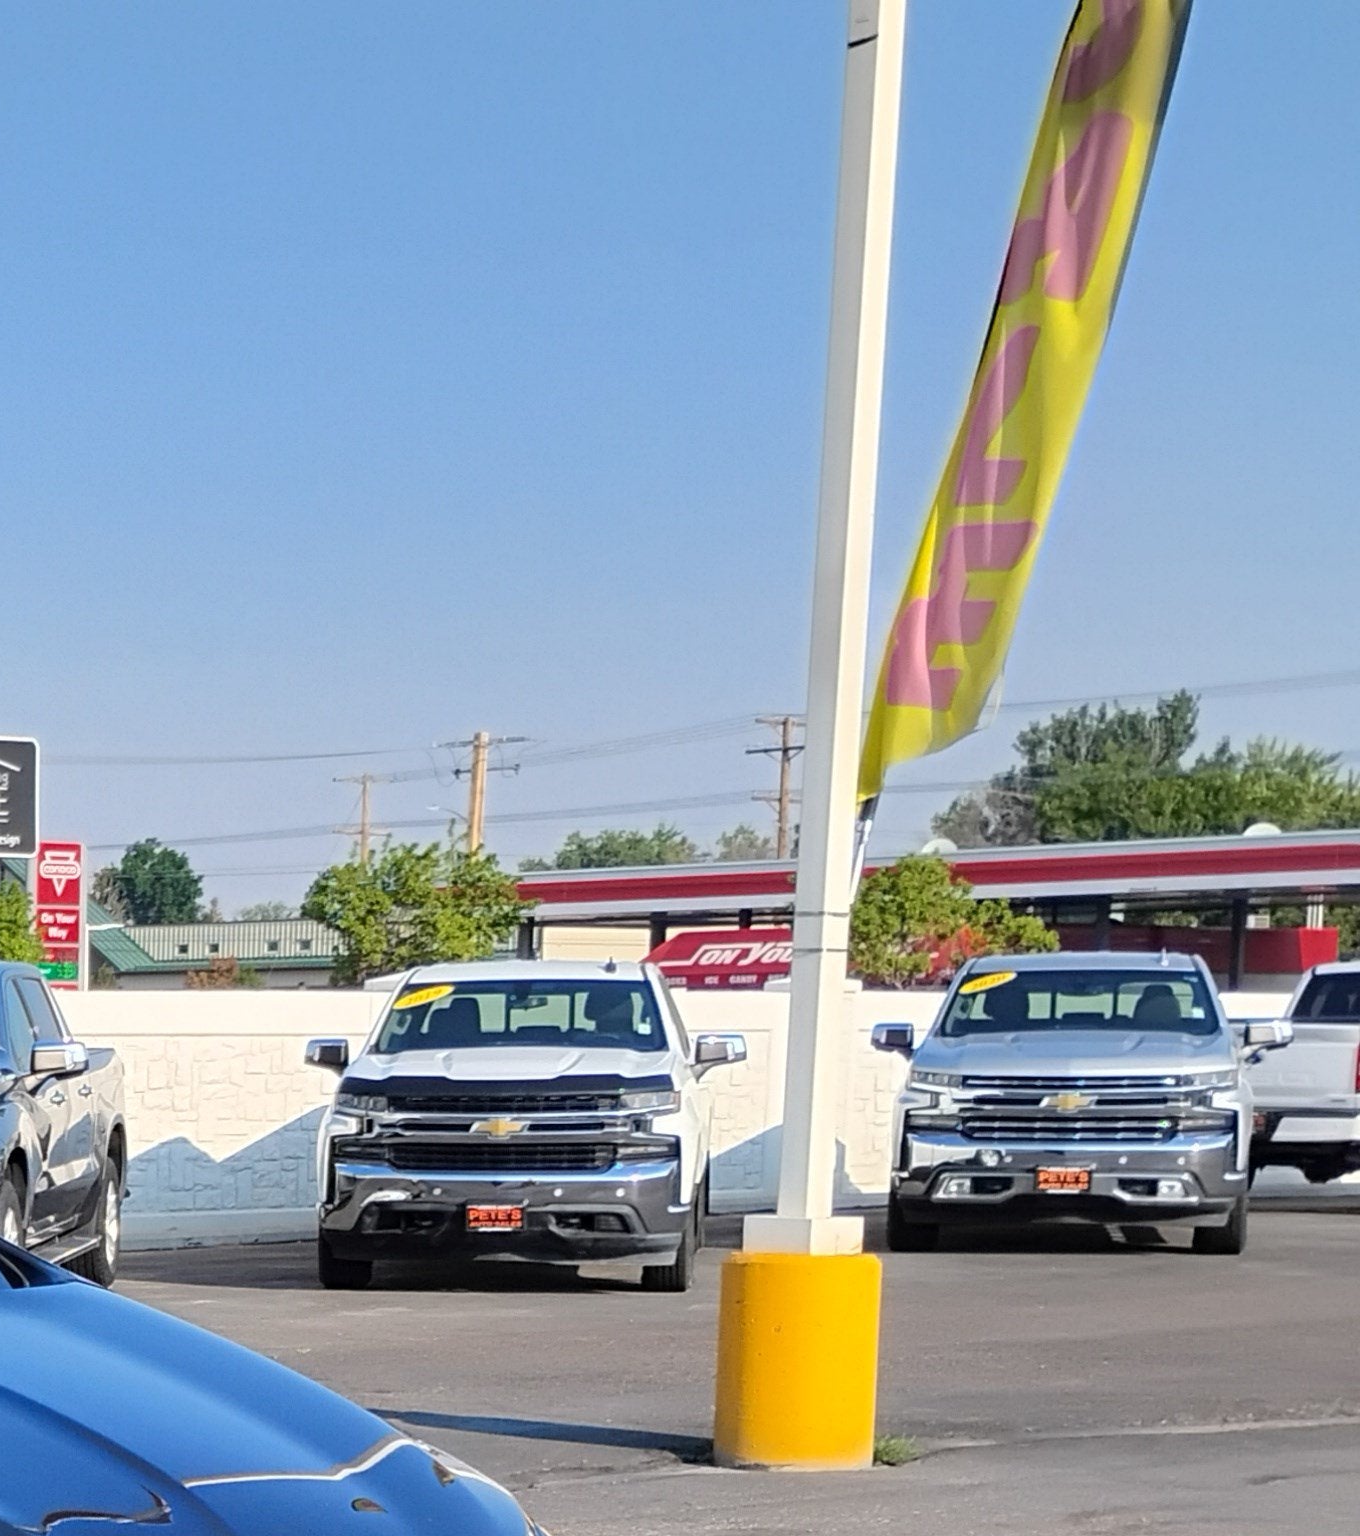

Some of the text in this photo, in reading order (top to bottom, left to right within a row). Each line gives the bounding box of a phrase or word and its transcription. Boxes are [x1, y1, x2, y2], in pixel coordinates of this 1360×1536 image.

[697, 942, 793, 967] ON YOU
[468, 1208, 522, 1220] PETE'S
